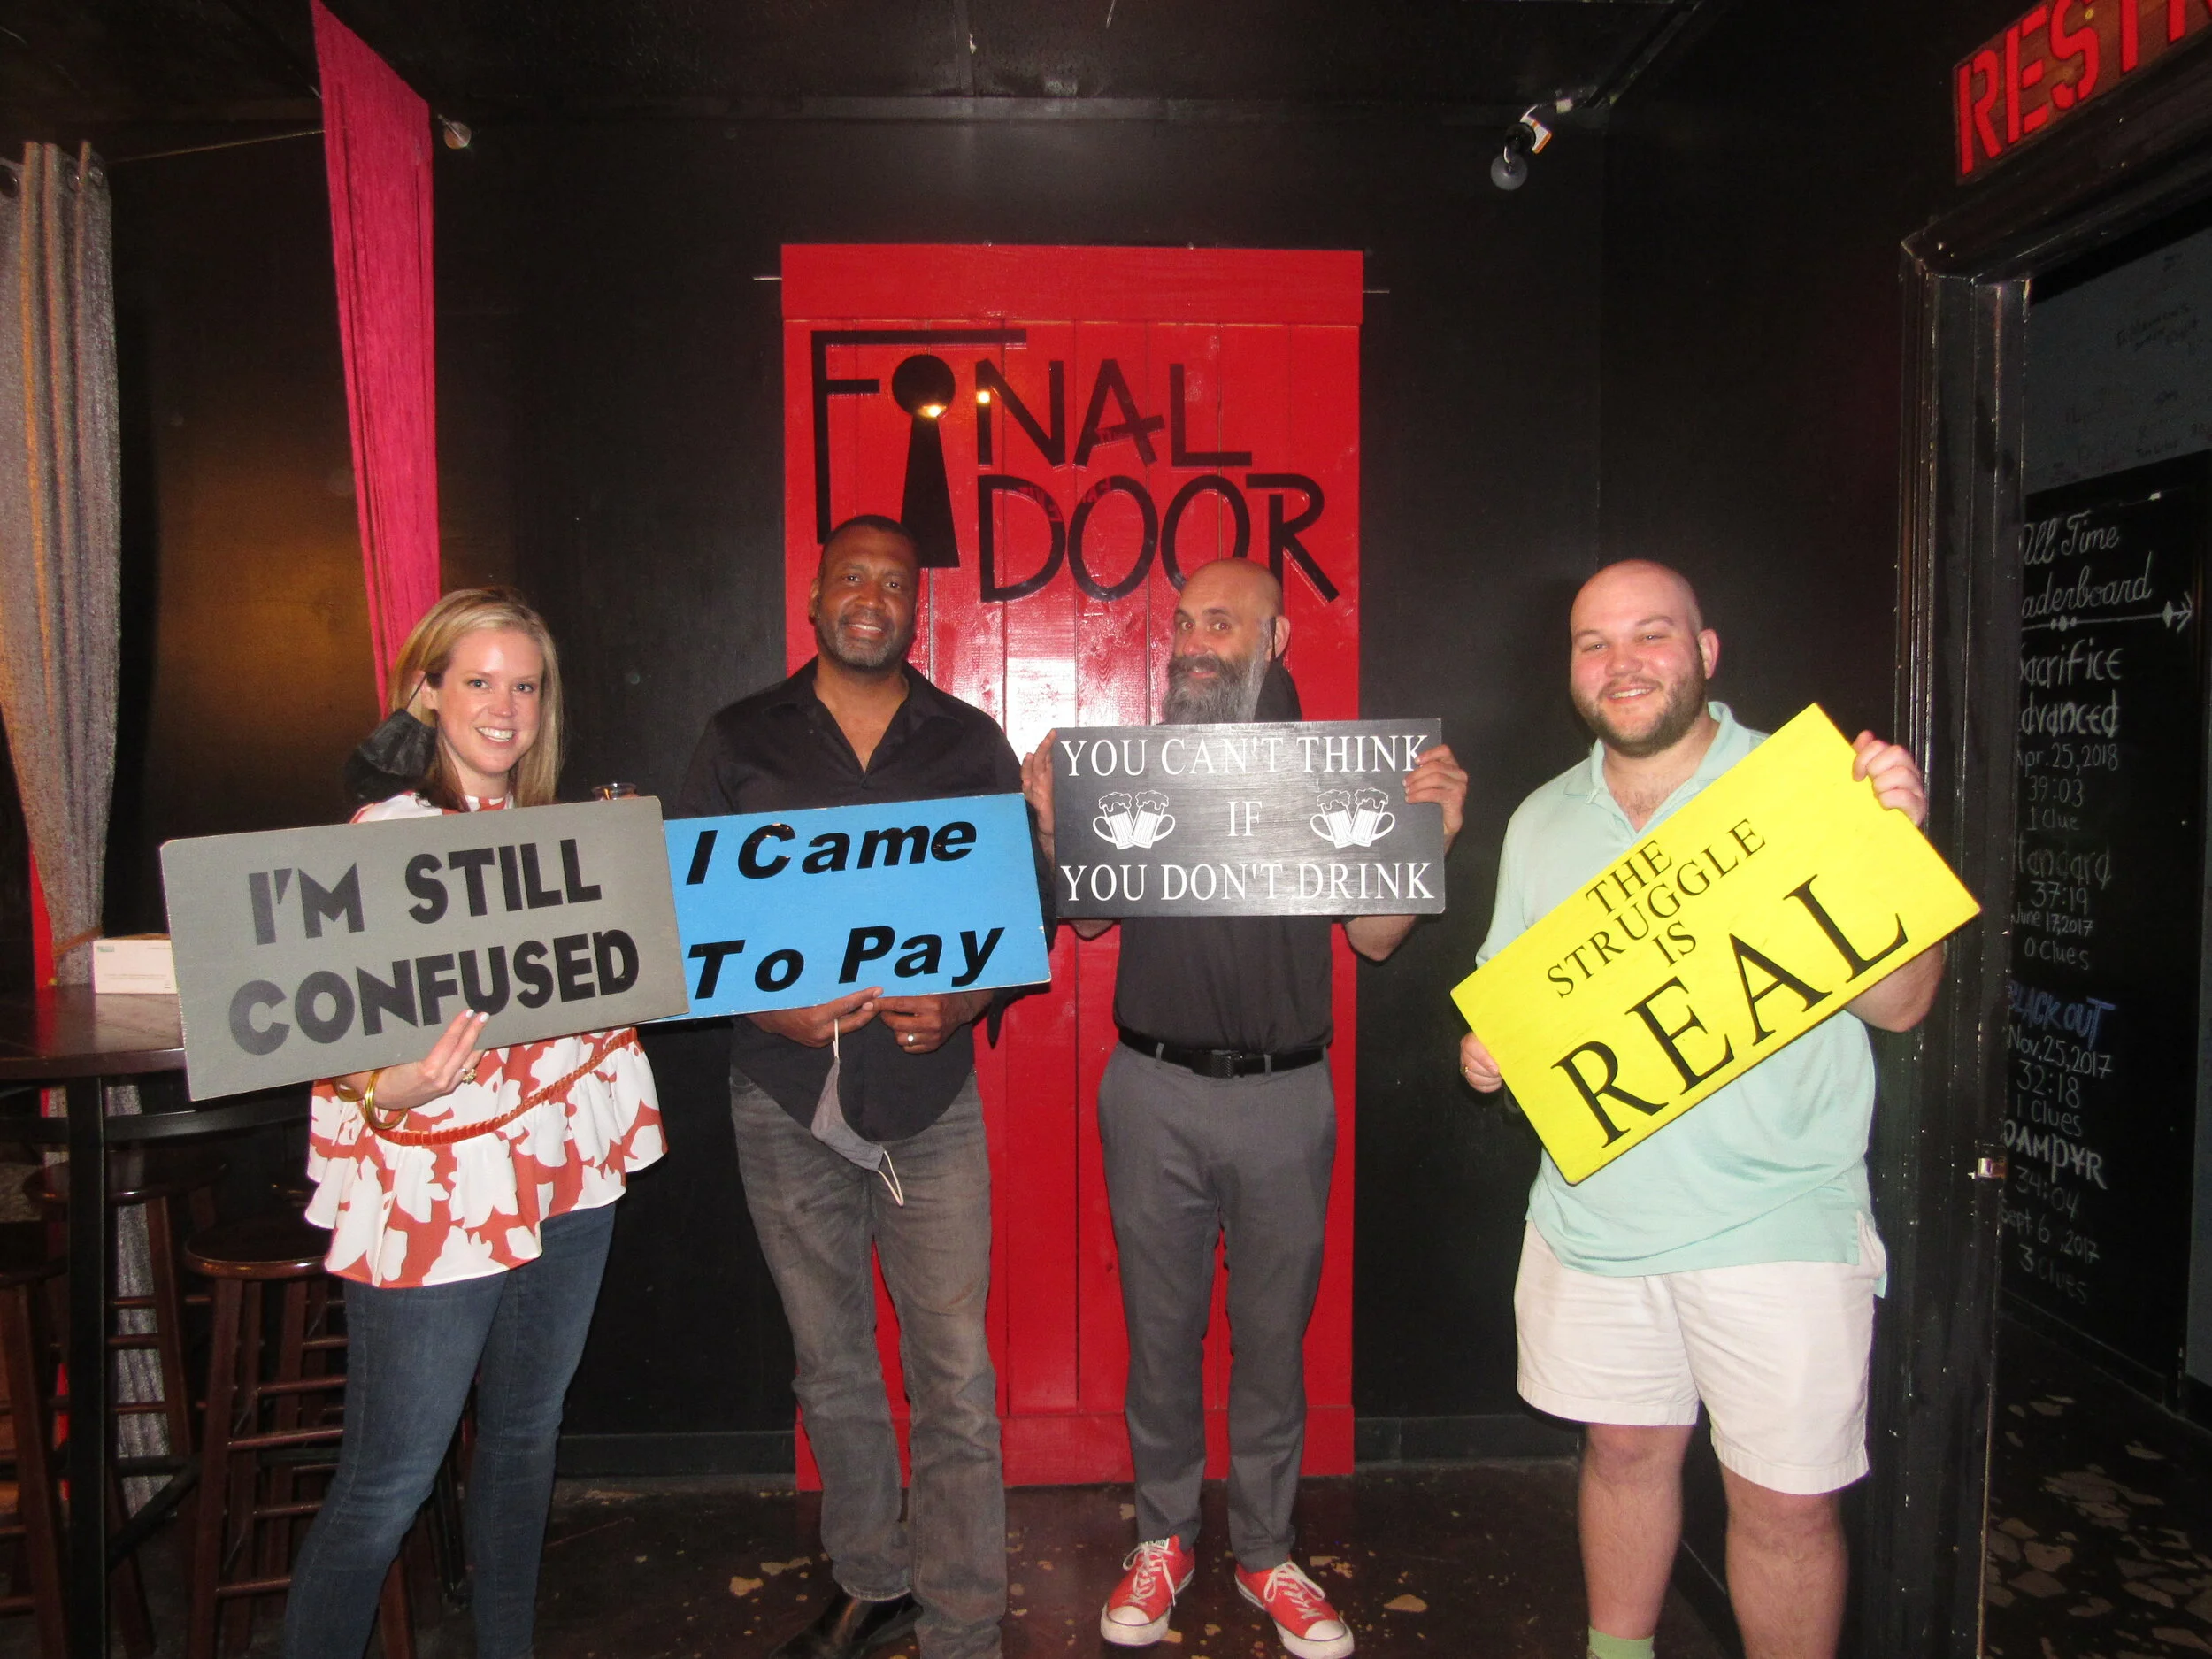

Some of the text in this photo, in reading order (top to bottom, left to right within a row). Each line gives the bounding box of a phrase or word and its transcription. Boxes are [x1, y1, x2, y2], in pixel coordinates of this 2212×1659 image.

[977, 472, 1340, 603] DOOR
[2061, 509, 2120, 556] Time
[2021, 688, 2121, 738] dvanced
[1061, 734, 1429, 777] YOU CAN'T THINK
[686, 821, 977, 886] I Came
[1227, 801, 1263, 837] IF
[249, 839, 602, 946] I'M STILL
[1061, 862, 1434, 902] YOU DON'T DRINK
[1546, 818, 1766, 998] STRUGGLE
[1585, 839, 1673, 917] THE
[687, 926, 1005, 1000] To Pay
[1650, 919, 1697, 966] IS
[228, 929, 639, 1056] CONFUSED
[1549, 873, 1909, 1148] REAL
